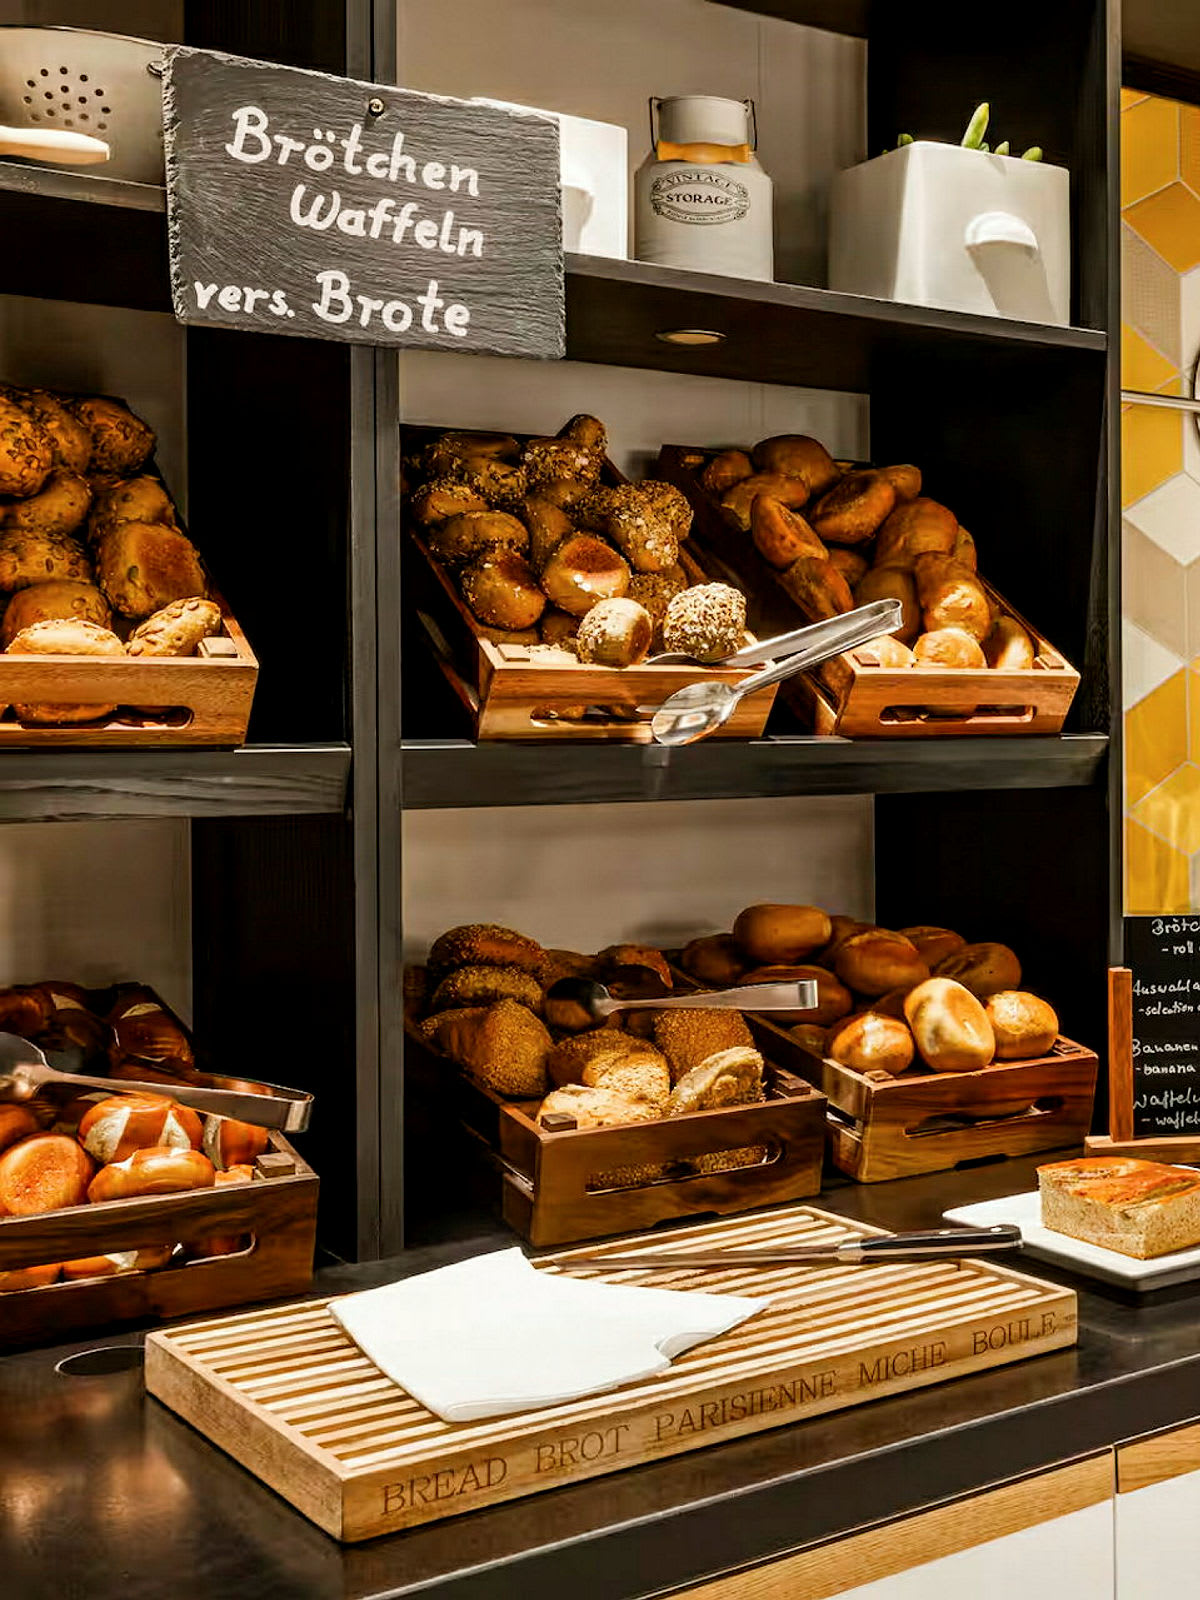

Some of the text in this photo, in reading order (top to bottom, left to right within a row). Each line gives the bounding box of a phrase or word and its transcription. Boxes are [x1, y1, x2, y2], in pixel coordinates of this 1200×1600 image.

[225, 106, 480, 197] Brötchen
[290, 184, 484, 257] Waffeln
[665, 193, 733, 206] STORAGE
[194, 270, 471, 337] vers. Brote
[1133, 979, 1190, 996] Auswahl
[380, 1311, 1058, 1516] BREAD BROT PARISIENNE MICHE BOULE
